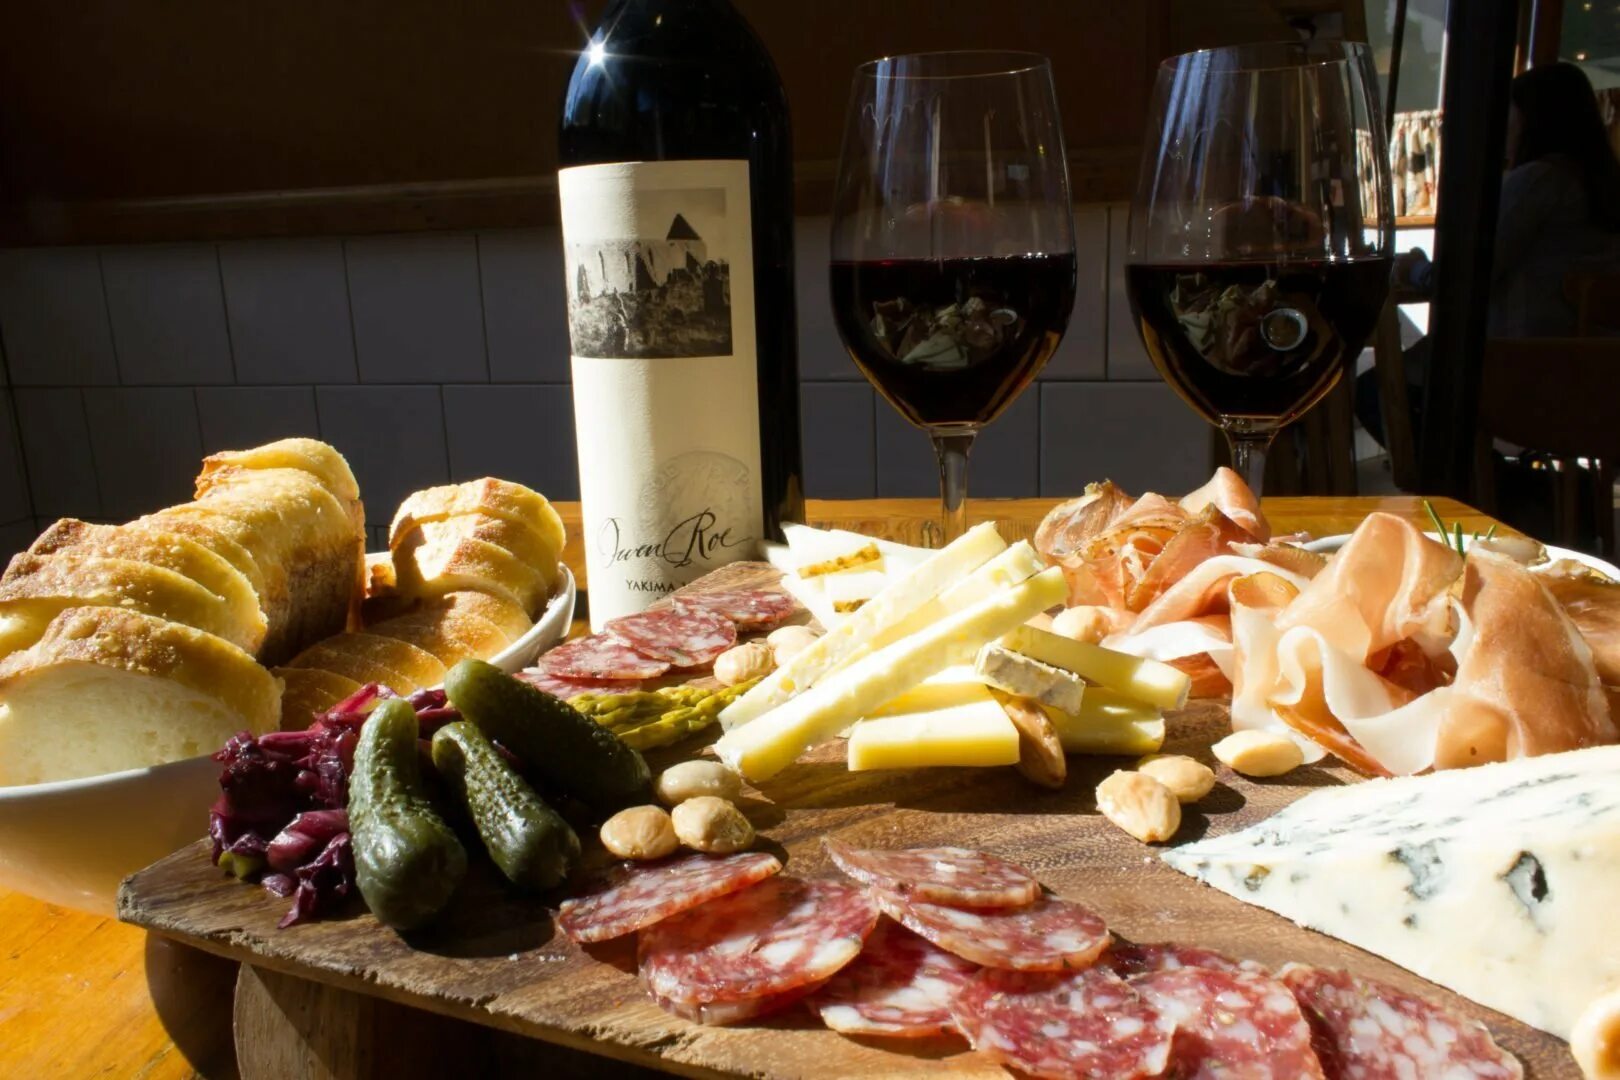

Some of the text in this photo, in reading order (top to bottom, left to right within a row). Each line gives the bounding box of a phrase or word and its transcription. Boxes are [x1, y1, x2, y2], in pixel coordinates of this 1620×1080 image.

[597, 507, 753, 568] Owen Roe
[626, 579, 676, 592] YAKIMA
